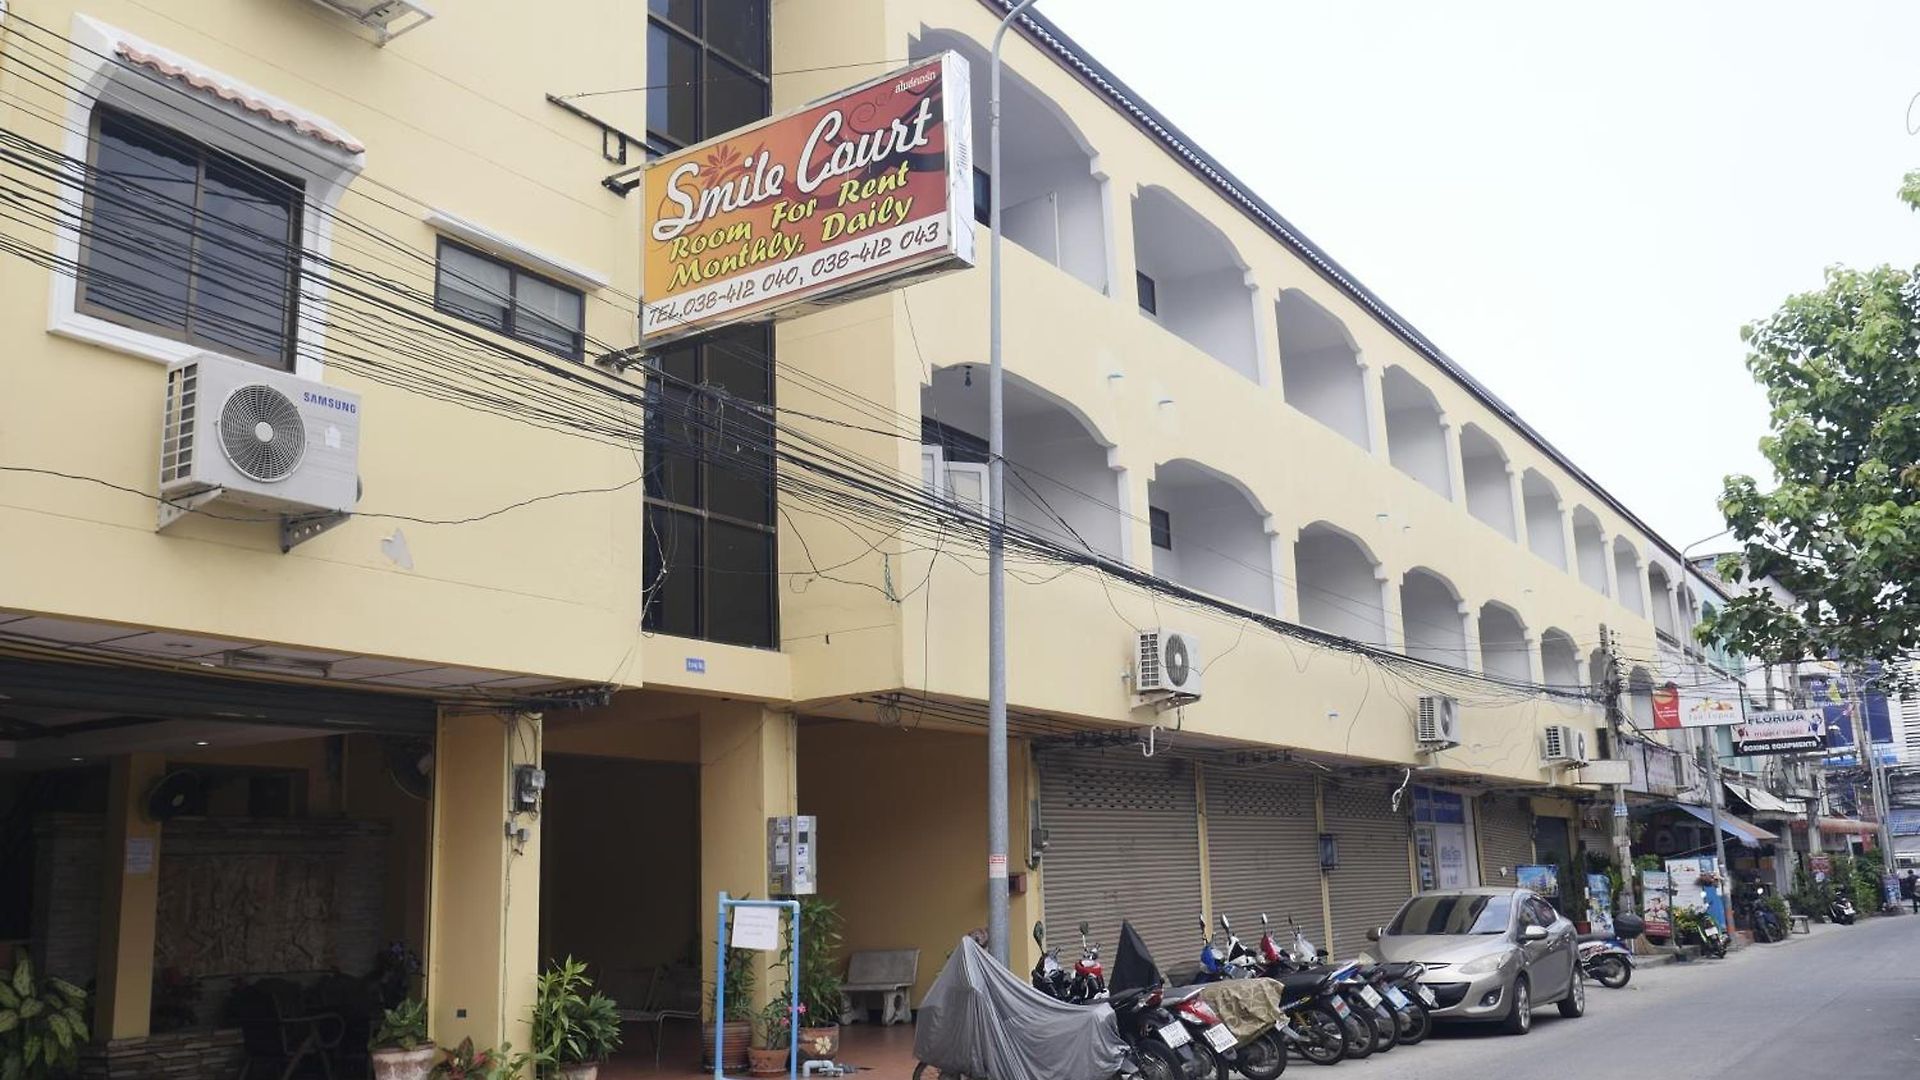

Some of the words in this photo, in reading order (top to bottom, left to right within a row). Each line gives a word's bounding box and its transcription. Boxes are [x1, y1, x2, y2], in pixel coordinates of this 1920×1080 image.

[652, 151, 785, 241] Smile
[796, 97, 932, 195] Court
[667, 231, 806, 293] Monthly,
[821, 195, 913, 243] Daily
[670, 220, 751, 262] Room
[771, 198, 818, 230] For
[840, 161, 910, 203] Rent
[762, 265, 805, 288] 040,
[811, 237, 892, 277] 038-412
[900, 221, 940, 250] 043
[303, 391, 356, 414] SAMSUNG
[1747, 712, 1805, 726] FLORIDA
